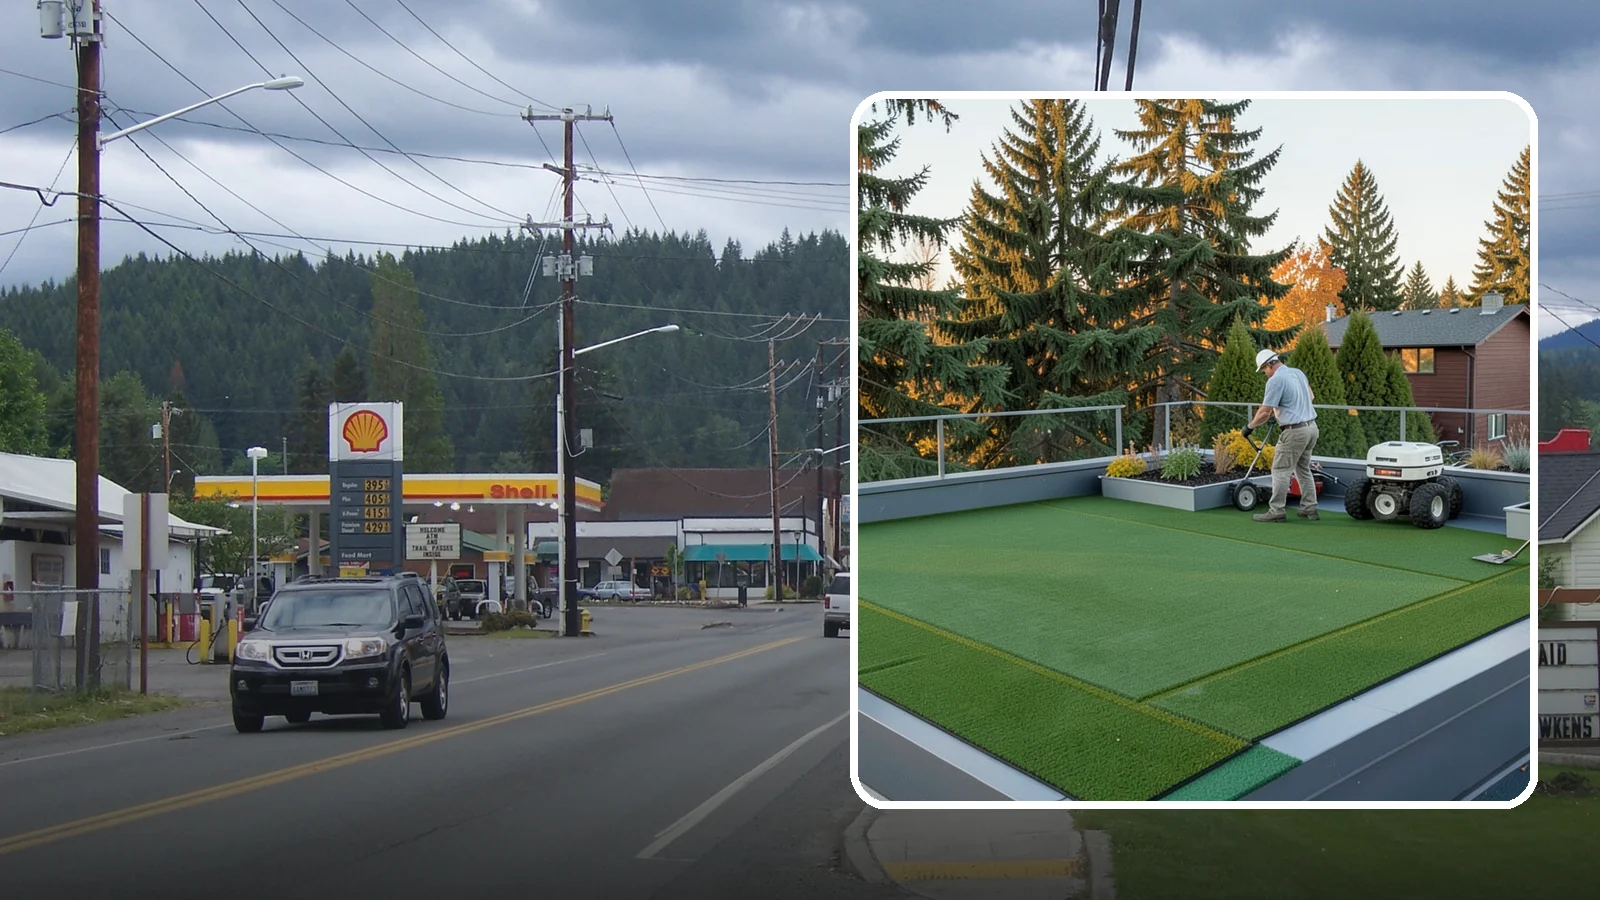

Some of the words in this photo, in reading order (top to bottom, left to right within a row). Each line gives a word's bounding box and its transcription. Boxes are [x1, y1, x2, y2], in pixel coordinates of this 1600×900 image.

[366, 480, 383, 490] 395
[490, 484, 547, 499] Shell
[365, 494, 383, 504] 405
[365, 508, 383, 518] 415
[366, 523, 383, 532] 429
